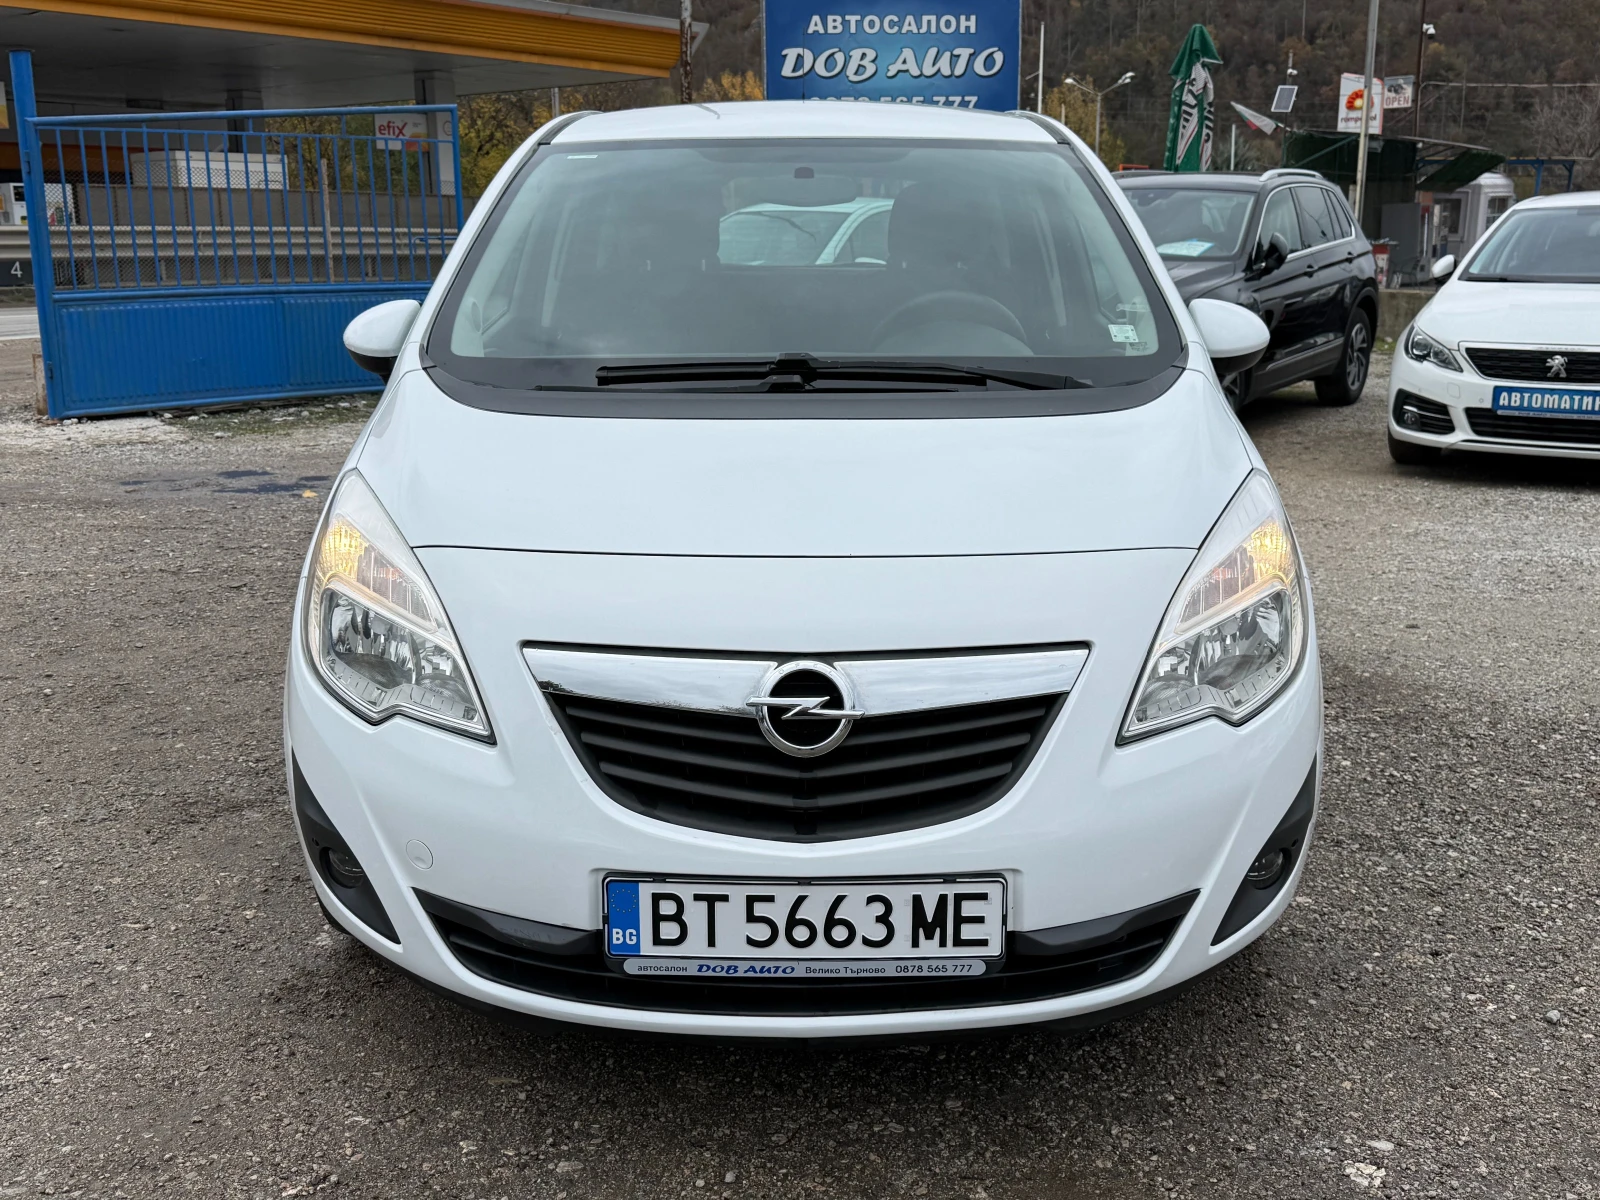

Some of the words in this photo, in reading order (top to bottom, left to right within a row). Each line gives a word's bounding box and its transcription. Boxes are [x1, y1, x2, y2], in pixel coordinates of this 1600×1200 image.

[807, 14, 977, 34] АВТОСАЛОН
[780, 47, 878, 83] DOB
[886, 46, 1005, 79] AUTO
[1385, 96, 1410, 107] OPEN
[378, 120, 408, 138] efix
[10, 261, 23, 278] 4
[651, 892, 730, 948] BT
[745, 893, 895, 948] 5663
[911, 892, 989, 948] ME
[612, 928, 637, 945] BG
[637, 964, 688, 973] автосалон
[697, 963, 739, 975] DOB
[743, 964, 796, 975] AUTO
[805, 966, 841, 974] Велико
[843, 966, 886, 975] Търново
[895, 964, 924, 973] 0878
[927, 964, 948, 973] 565
[952, 964, 973, 973] 777
